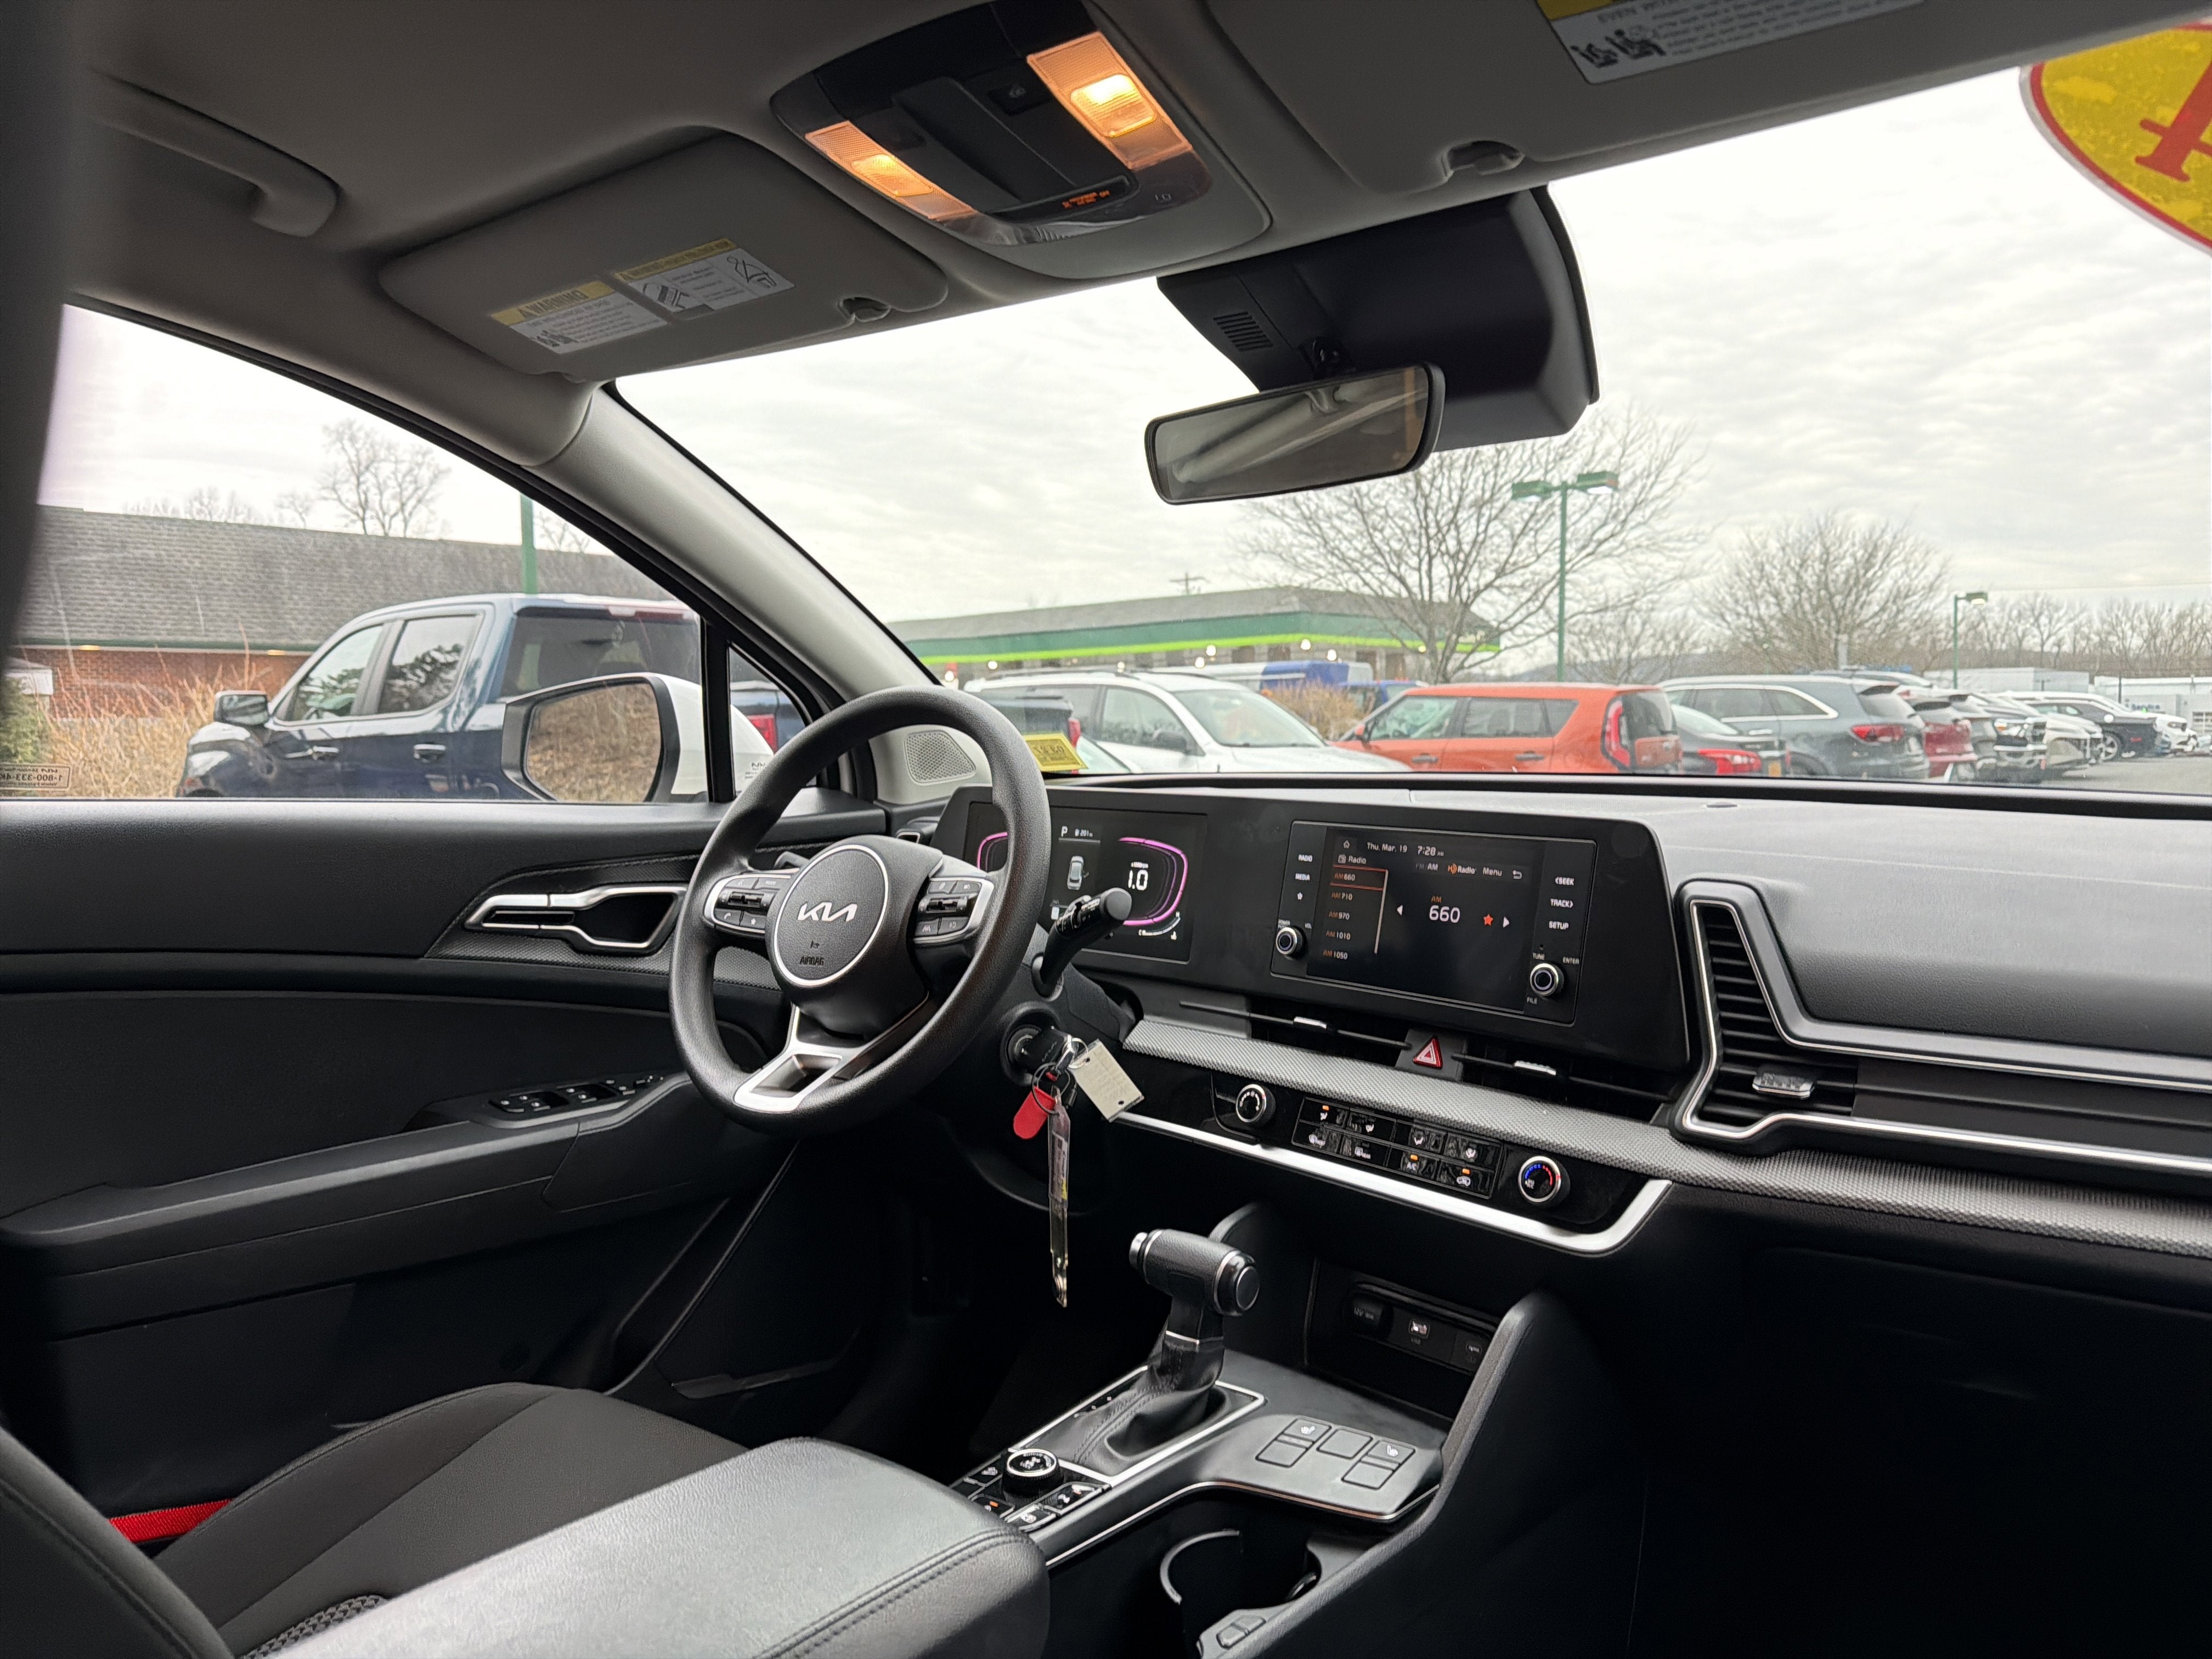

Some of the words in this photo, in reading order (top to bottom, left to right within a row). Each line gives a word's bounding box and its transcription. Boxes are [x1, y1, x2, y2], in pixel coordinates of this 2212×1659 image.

[1061, 826, 1068, 837] P
[1348, 855, 1367, 865] Radio
[1457, 865, 1475, 874] Radio
[1482, 867, 1503, 877] Menu
[1128, 869, 1148, 891] 1.0
[1295, 873, 1310, 881] MEDIA
[1429, 905, 1460, 923] 660
[1549, 921, 1569, 930] SETUP
[1532, 952, 1545, 961] TUNE
[1562, 956, 1579, 965] ENTER
[1527, 996, 1538, 1005] FILE
